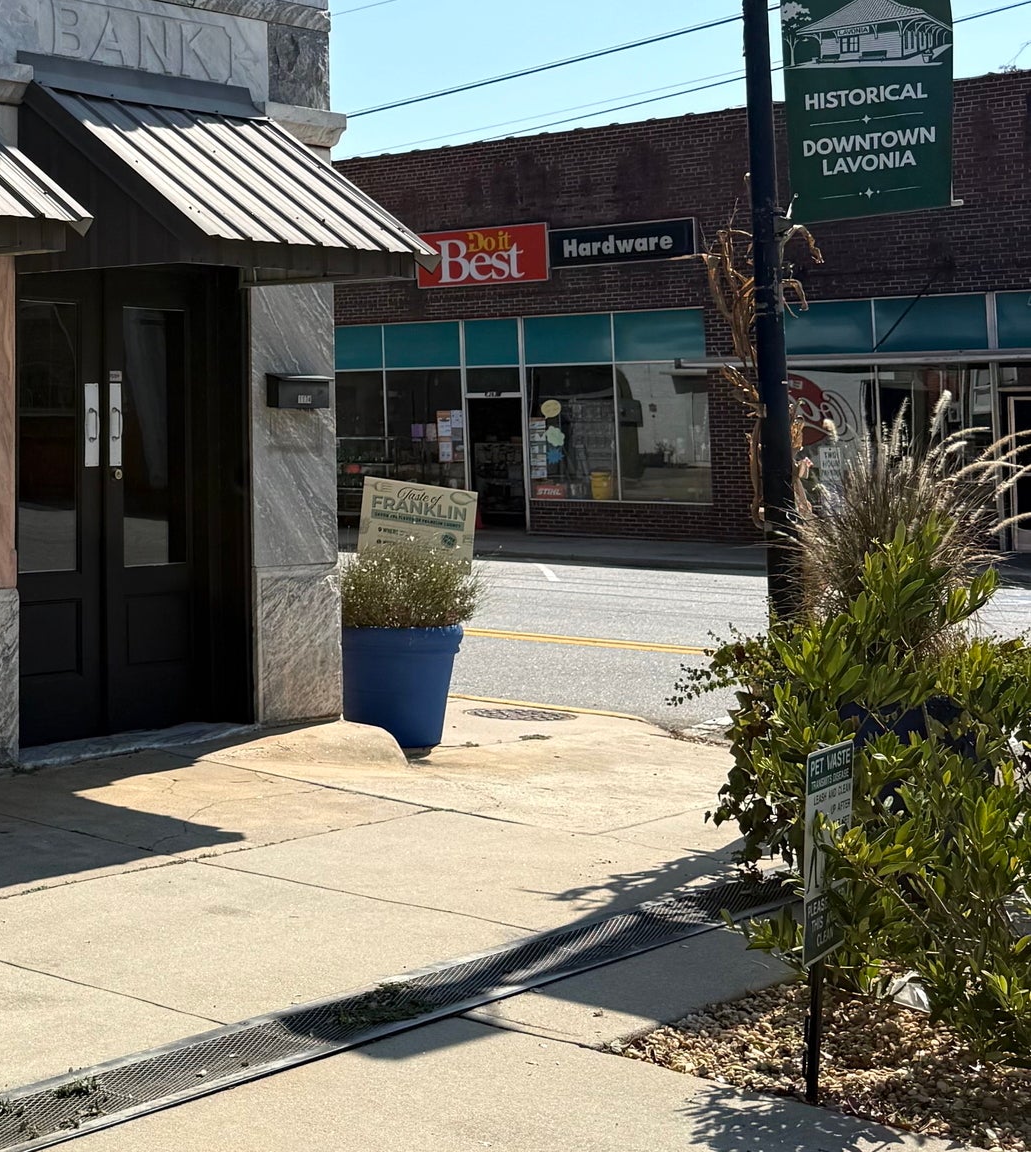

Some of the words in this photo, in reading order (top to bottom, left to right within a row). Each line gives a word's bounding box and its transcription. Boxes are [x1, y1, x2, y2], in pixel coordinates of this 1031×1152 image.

[51, 0, 219, 81] BANK
[804, 82, 928, 110] HISTORICAL
[803, 126, 936, 157] DOWNTOWN
[822, 150, 917, 176] LAVONIA
[466, 231, 495, 253] Do
[498, 230, 512, 250] it
[562, 234, 674, 258] Hardware
[436, 239, 525, 283] Best
[371, 495, 467, 521] FRANKLIN
[397, 486, 429, 502] Taste
[430, 494, 444, 509] of
[810, 757, 825, 777] PET
[826, 748, 851, 771] WASTE
